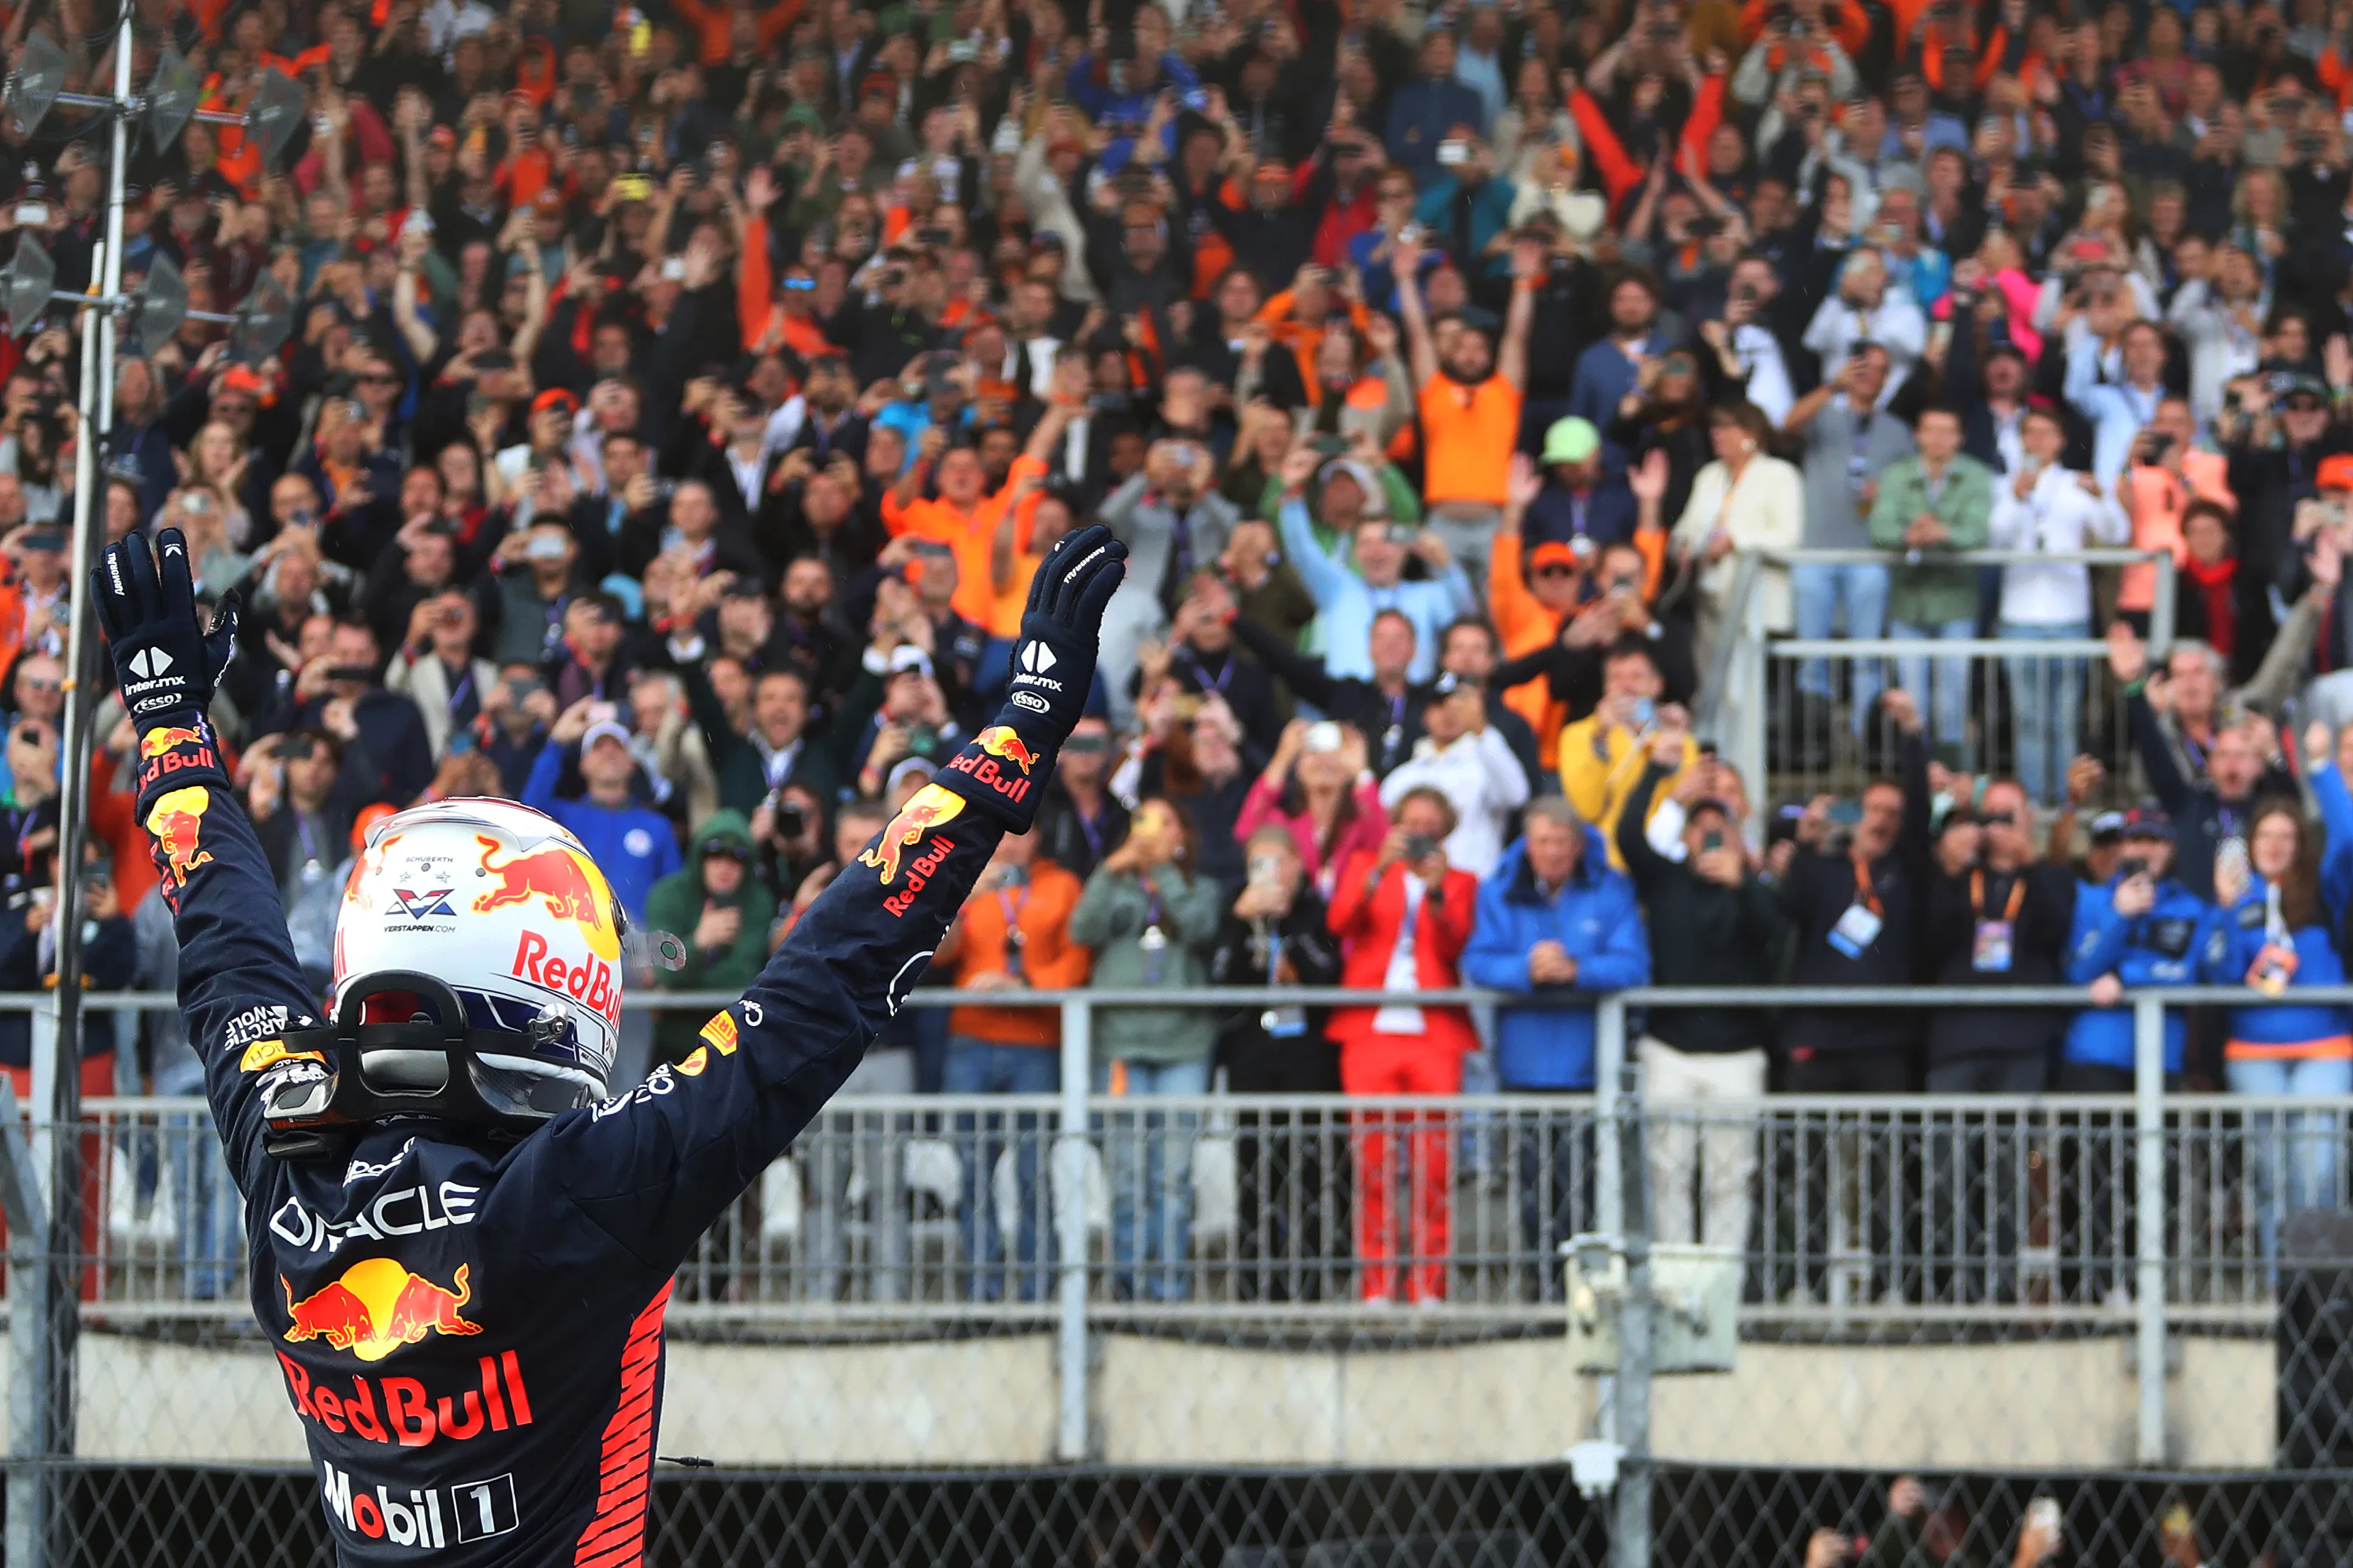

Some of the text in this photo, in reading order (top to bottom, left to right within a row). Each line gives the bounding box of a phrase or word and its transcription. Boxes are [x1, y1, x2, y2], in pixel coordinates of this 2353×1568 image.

[125, 675, 186, 697] inter.mx
[162, 747, 214, 773] Bull
[974, 758, 1032, 803] Bull
[883, 834, 957, 917] Red Bull
[384, 924, 456, 933] VERSTAPPEN.COM
[512, 929, 594, 1000] Red
[224, 1018, 285, 1051] ARCTIC
[226, 1006, 274, 1039] WOLF
[275, 1349, 533, 1447] Red Bull
[324, 1459, 496, 1548] Mobil 1
